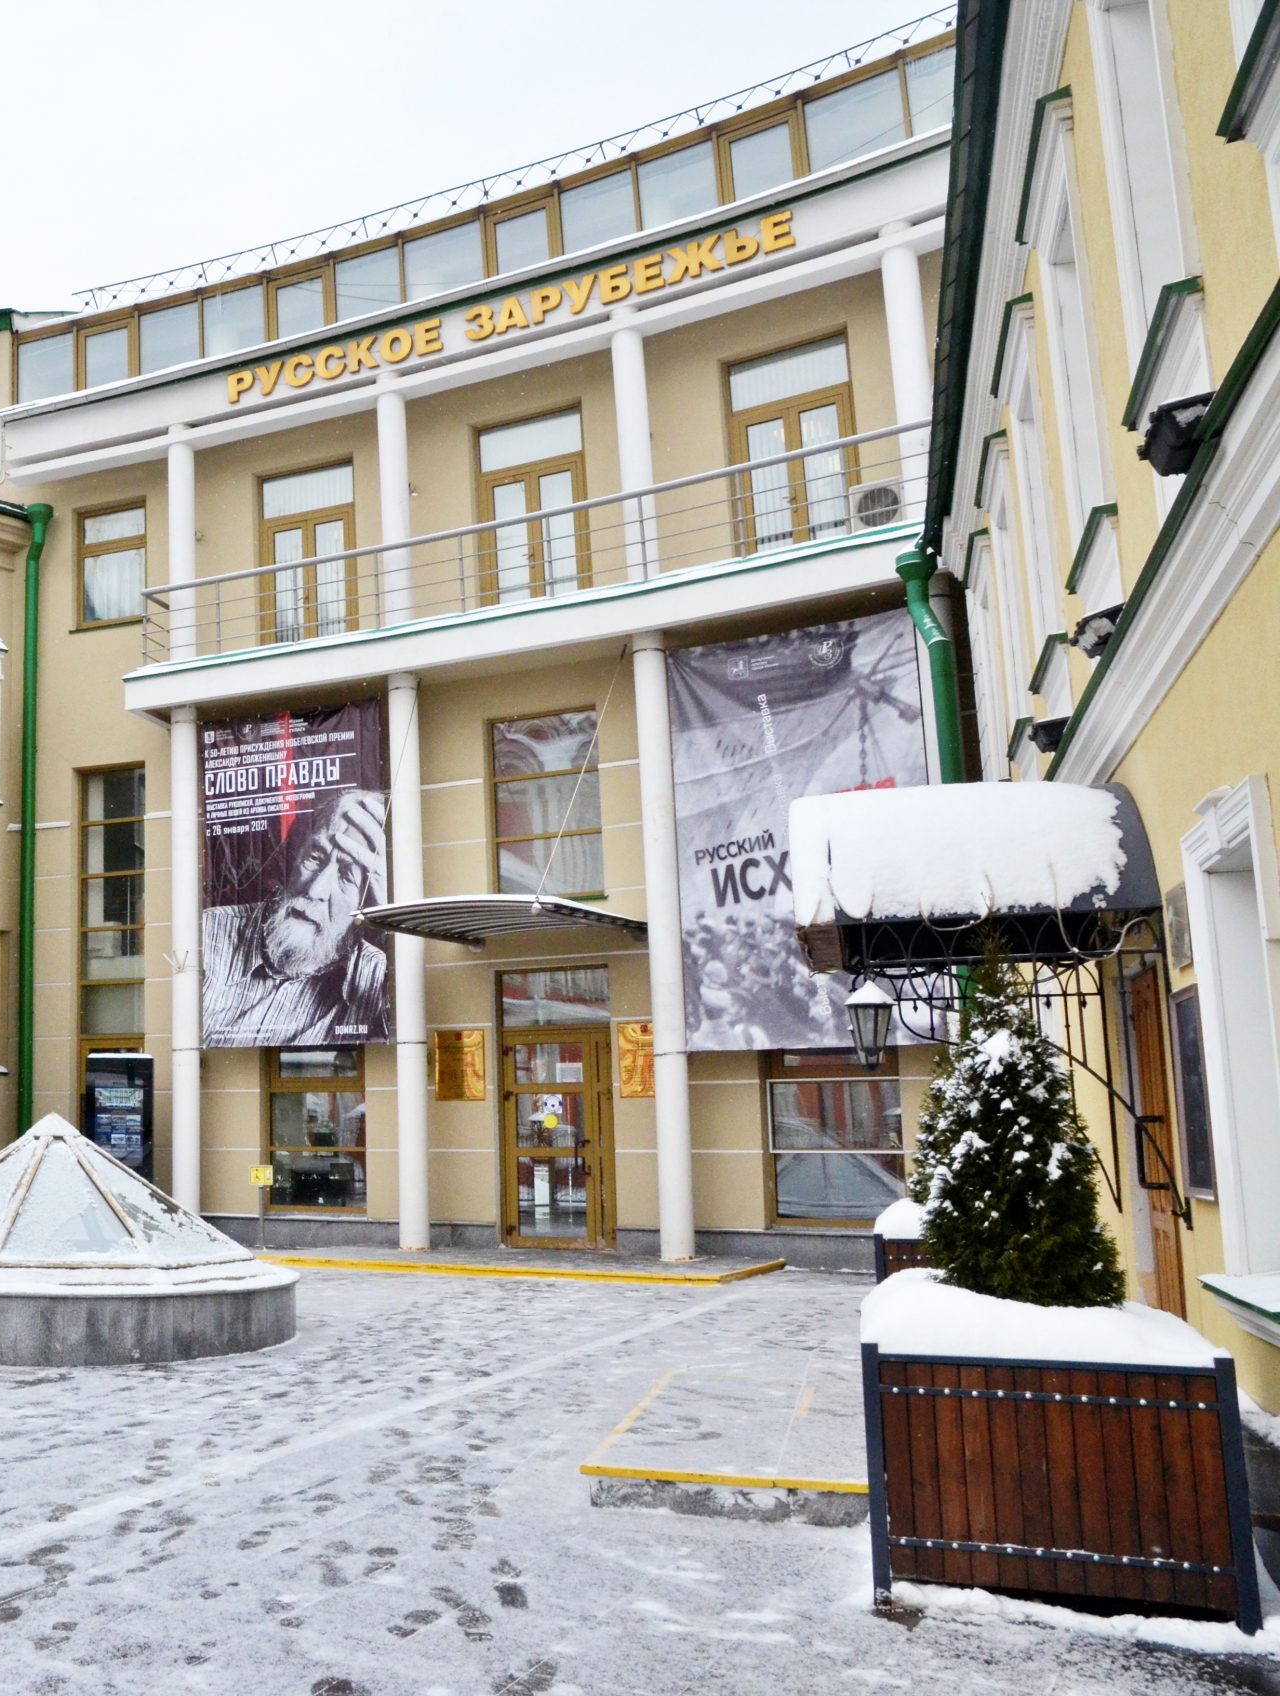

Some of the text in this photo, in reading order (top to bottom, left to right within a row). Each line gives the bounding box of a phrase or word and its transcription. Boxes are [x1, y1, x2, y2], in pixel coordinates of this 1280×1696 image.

[227, 211, 796, 403] РУССКОЕ ЗАРУБЕЖЬЕ
[757, 693, 777, 755] Выставка
[205, 731, 355, 758] К 50-ЛЕТИЮ ПРИСУЖДЕНИЯ НОБЕЛЕВСКОЙ ПРЕМИИ
[205, 751, 287, 769] АЛЕКСАНДРУ СОЛЖЕНИЦЫНУ
[205, 758, 340, 796] СЛОВО ПРАВДЫ
[212, 825, 221, 836] 26
[223, 825, 249, 835] января
[251, 820, 267, 832] 2021
[695, 829, 775, 866] РУССКИЙ
[711, 850, 793, 908] ИСХ
[335, 1025, 368, 1035] DOMRZ.RU
